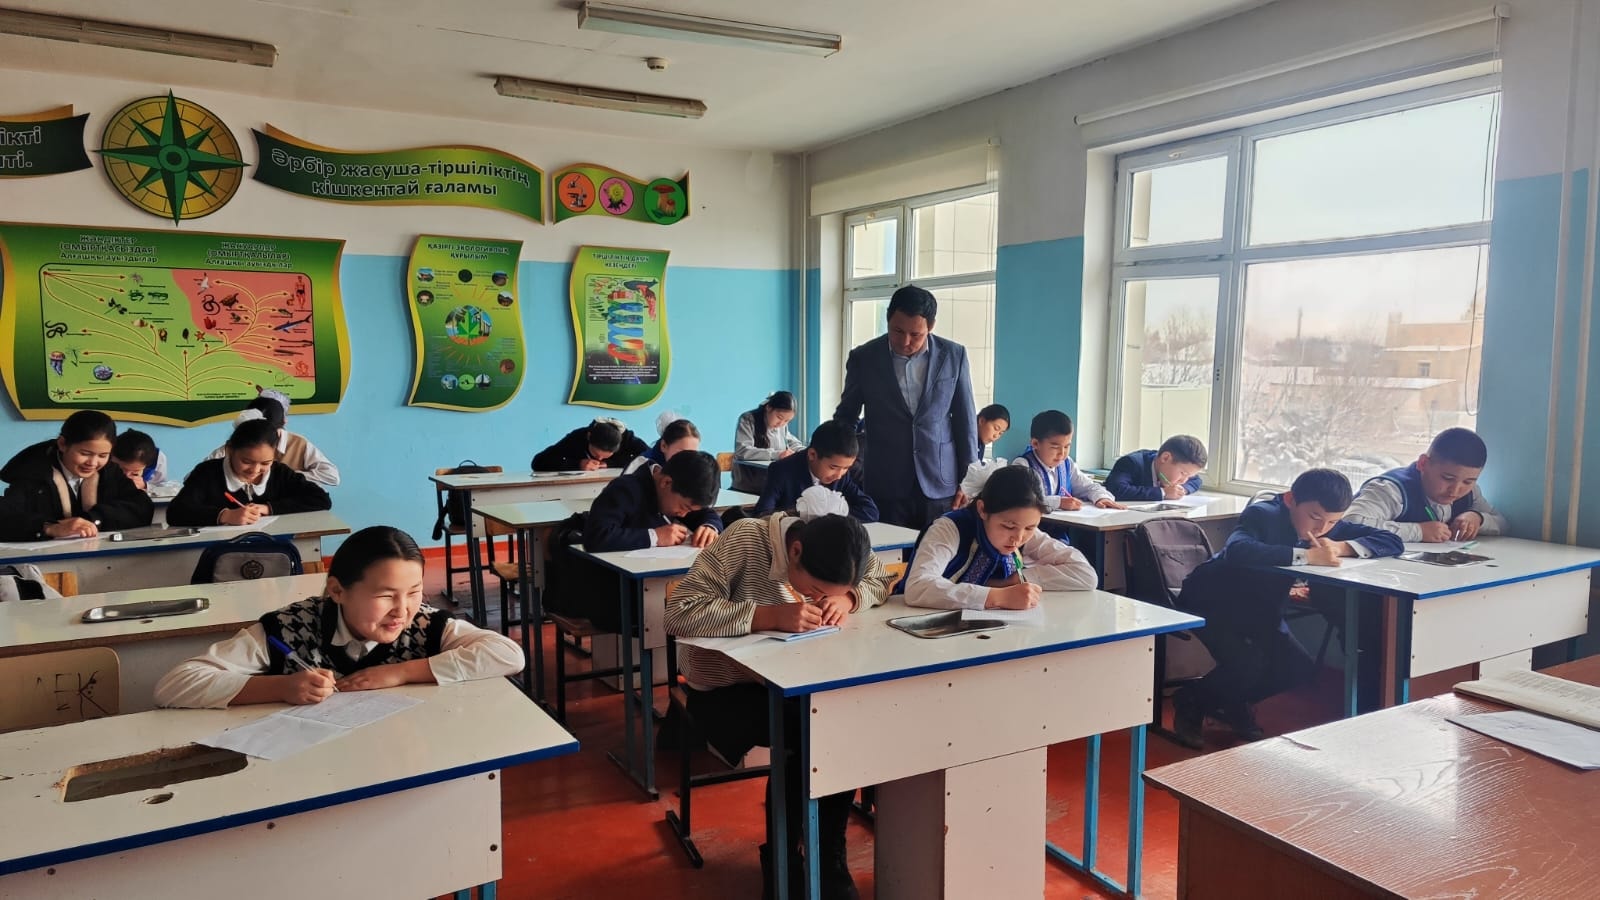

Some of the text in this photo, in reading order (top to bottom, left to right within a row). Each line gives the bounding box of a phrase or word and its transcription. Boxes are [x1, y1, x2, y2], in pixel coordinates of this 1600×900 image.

[271, 148, 530, 188] Әрбір жасуша-тіршіліктің
[312, 180, 498, 198] кішкентай ғаламы
